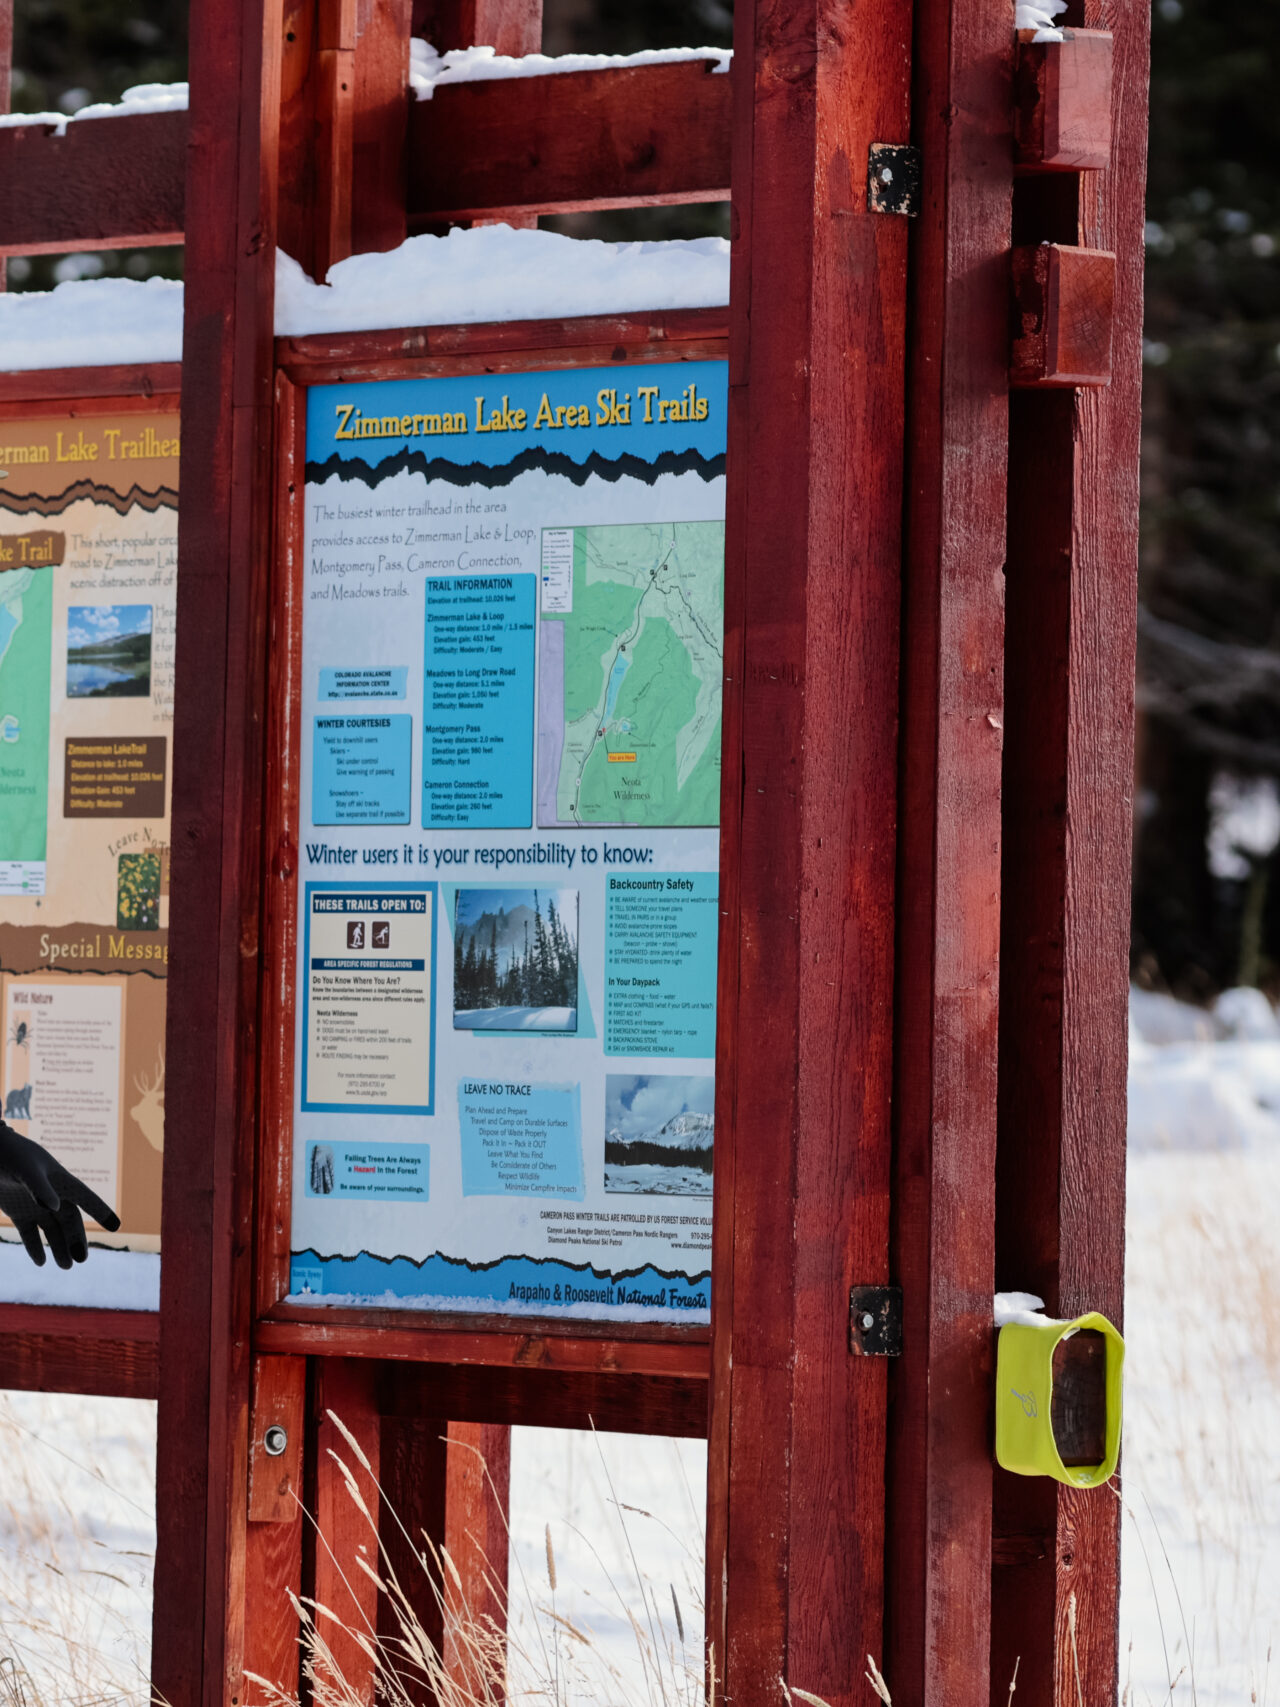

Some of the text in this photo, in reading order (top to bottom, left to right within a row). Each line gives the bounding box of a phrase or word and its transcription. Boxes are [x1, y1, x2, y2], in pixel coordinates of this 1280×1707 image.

[335, 384, 709, 439] Zimmerman Lake Area Ski Trails
[56, 431, 98, 462] Lake
[104, 427, 180, 460] Trailhea
[313, 498, 507, 523] The busiest winter trailhead in the area
[71, 534, 93, 549] This
[122, 531, 157, 551] popular
[311, 523, 537, 553] provides access to Zimmerman Lake & Loop,
[18, 536, 53, 562] Trail
[70, 557, 91, 569] road
[93, 558, 103, 568] to
[104, 553, 154, 570] Zimmerman
[311, 558, 375, 578] Montgomery
[407, 553, 455, 573] Cameron
[457, 551, 522, 570] Connection,
[428, 579, 513, 591] TRAIL INFORMATION
[310, 584, 329, 600] and
[331, 586, 381, 601] Meadows
[427, 612, 504, 622] Zimmerman Lake & Loop
[363, 670, 391, 678] AVALANCHE
[426, 669, 455, 677] Meadows
[465, 669, 480, 678] Long
[482, 668, 498, 676] Draw
[499, 667, 516, 675] Road
[317, 719, 391, 728] WINTER COURTESIES
[426, 724, 480, 734] Montgomery Pass
[425, 780, 489, 789] Cameron Connection
[613, 790, 650, 800] Wilderness
[306, 842, 653, 869] Winter users it is your responsibility to know:
[610, 878, 694, 892] Backcountry Safety
[314, 899, 424, 910] THESE TRAILS OPEN TO:
[39, 933, 101, 963] Special
[338, 960, 359, 968] SPECIFIC
[313, 976, 321, 984] Do
[322, 976, 333, 984] You
[335, 976, 351, 984] Know
[387, 977, 400, 985] Are?
[609, 977, 660, 988] In Your Daypack
[464, 1084, 531, 1096] LEAVE NO TRACE
[465, 1105, 476, 1113] Plan
[478, 1106, 495, 1114] Ahead
[345, 1154, 366, 1163] Falling
[368, 1155, 385, 1163] Trees
[399, 1156, 421, 1165] Always
[540, 1210, 713, 1226] CAMERON PASS WINTER TRAILS ARE PATROLLED BY US FOREST SERVICE VOLU
[547, 1226, 563, 1236] Canyon
[577, 1228, 593, 1237] Ranger
[644, 1230, 658, 1238] Nordic
[659, 1231, 678, 1240] Rangers
[548, 1236, 567, 1244] Diamond
[568, 1237, 582, 1245] Peaks
[583, 1237, 600, 1245] National
[509, 1281, 707, 1309] Arapaho & Roosevelt National Forests
